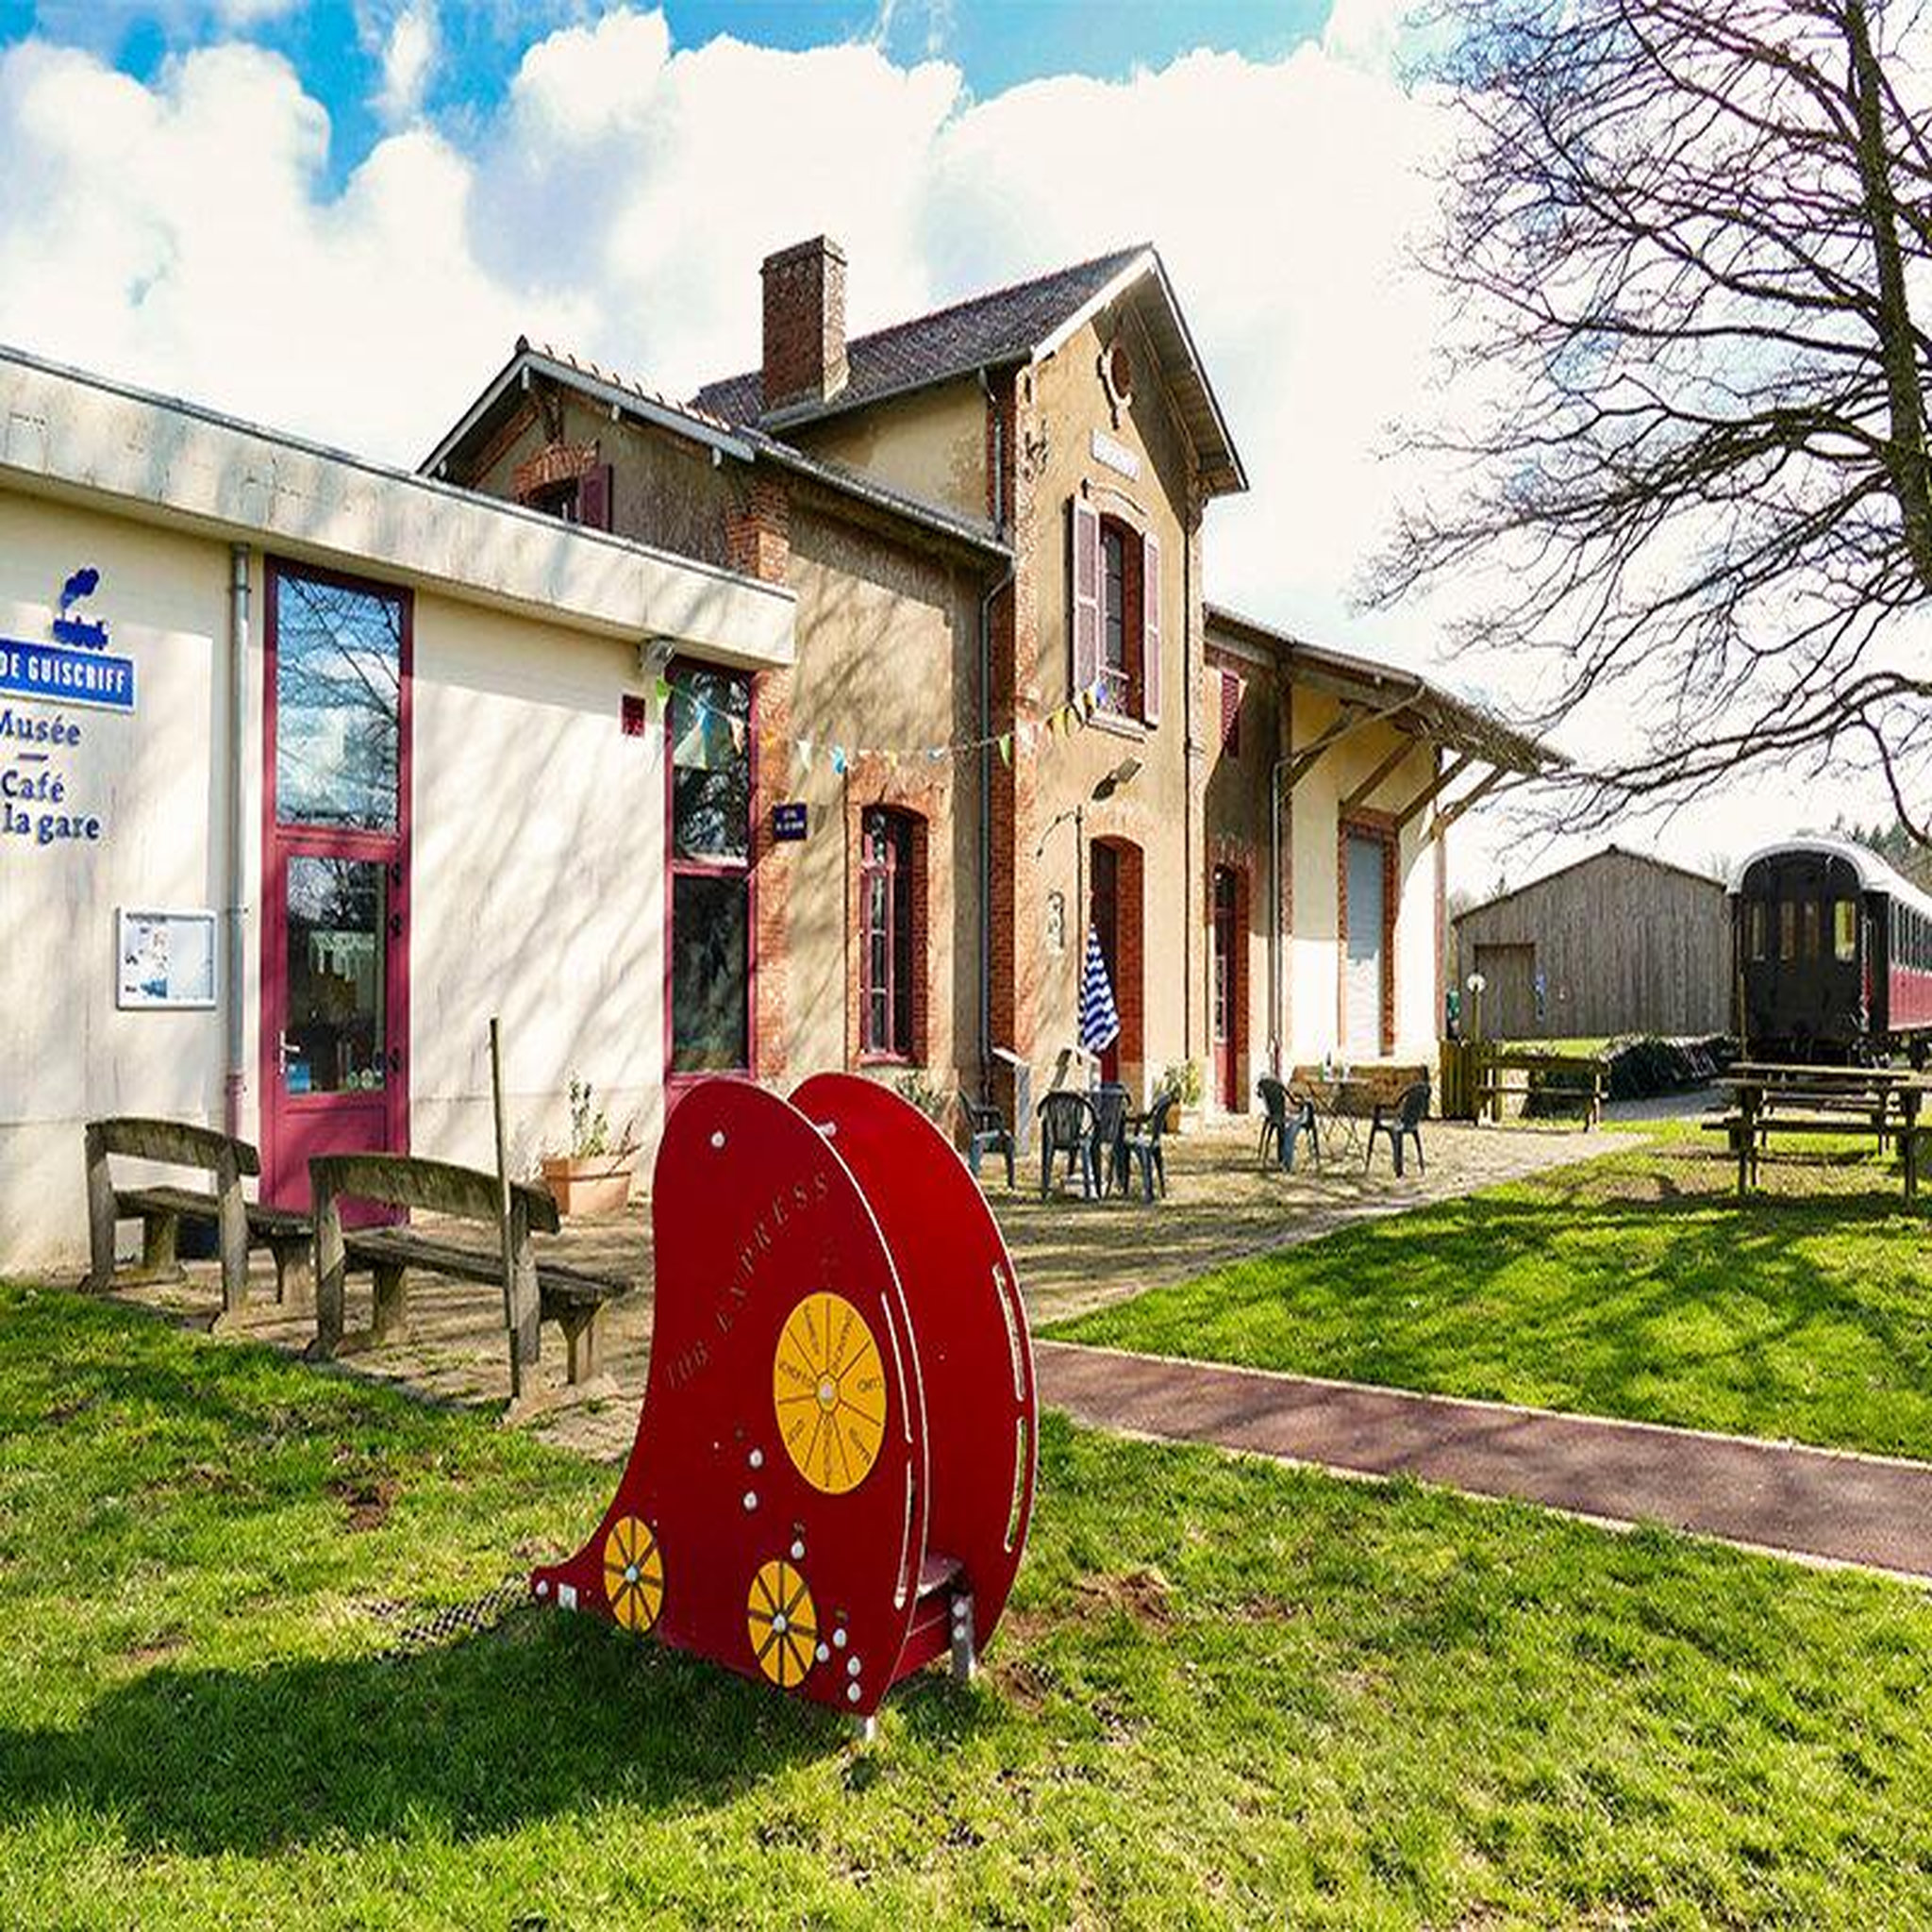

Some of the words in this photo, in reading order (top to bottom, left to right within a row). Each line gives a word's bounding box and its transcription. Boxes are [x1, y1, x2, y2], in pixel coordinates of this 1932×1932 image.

[0, 650, 20, 678] DE
[27, 655, 125, 693] GUISCRIFF
[1, 770, 64, 803] Café
[4, 803, 30, 834] la
[39, 814, 99, 844] gare
